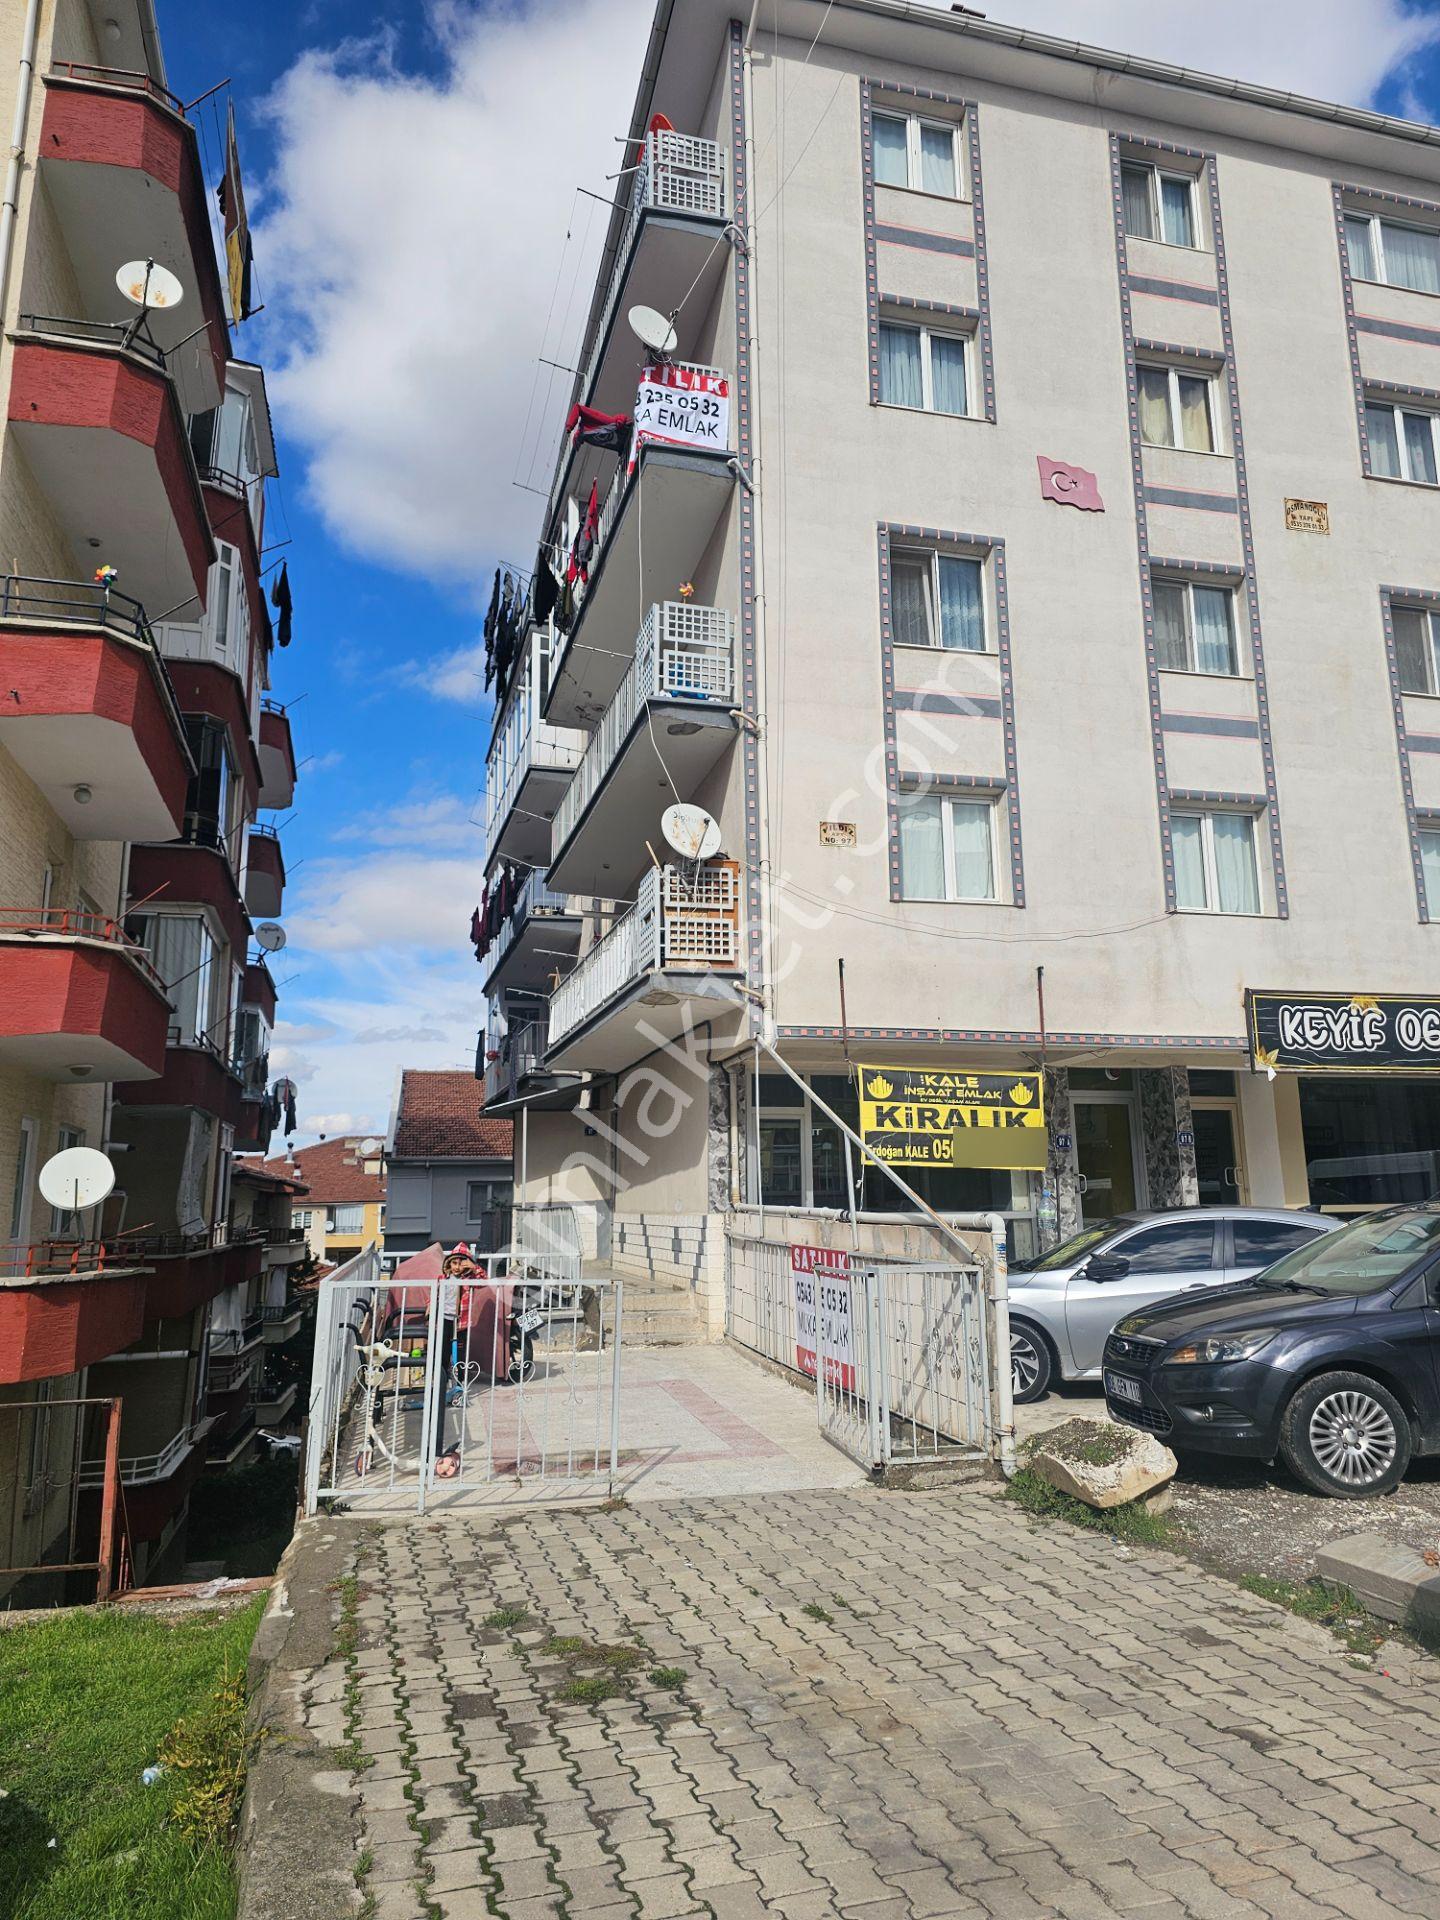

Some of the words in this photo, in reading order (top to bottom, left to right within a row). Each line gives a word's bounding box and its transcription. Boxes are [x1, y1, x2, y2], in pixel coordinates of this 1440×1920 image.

[658, 409, 719, 438] EMLAK
[924, 1074, 979, 1088] KALE
[956, 1089, 1002, 1099] EMLAK
[905, 1145, 929, 1158] KALE
[932, 1139, 953, 1159] 05
